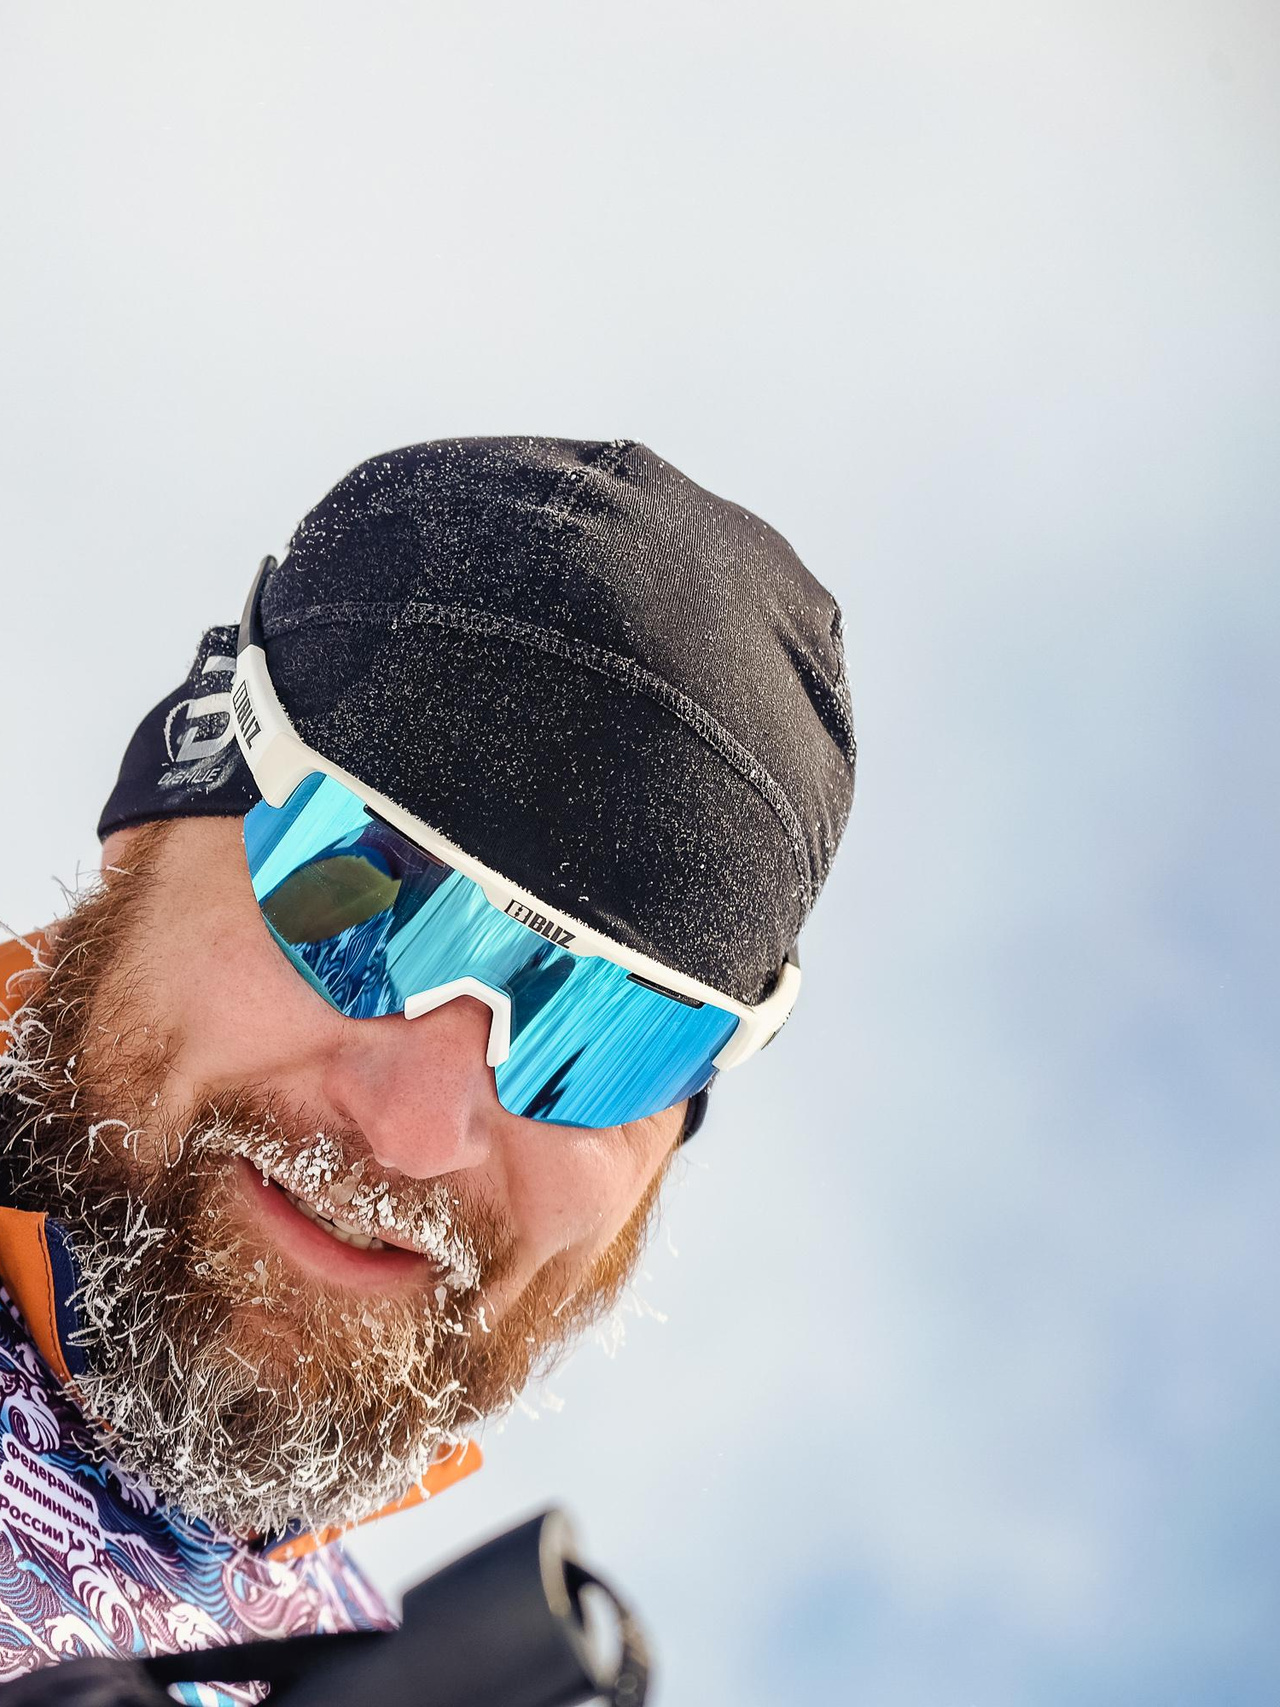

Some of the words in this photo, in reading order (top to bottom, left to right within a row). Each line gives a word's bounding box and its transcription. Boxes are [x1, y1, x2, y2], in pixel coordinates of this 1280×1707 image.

[237, 697, 262, 750] BLIZ
[528, 912, 577, 949] BLIZ
[3, 1469, 101, 1542] альпинизма
[6, 1441, 94, 1513] Федерация
